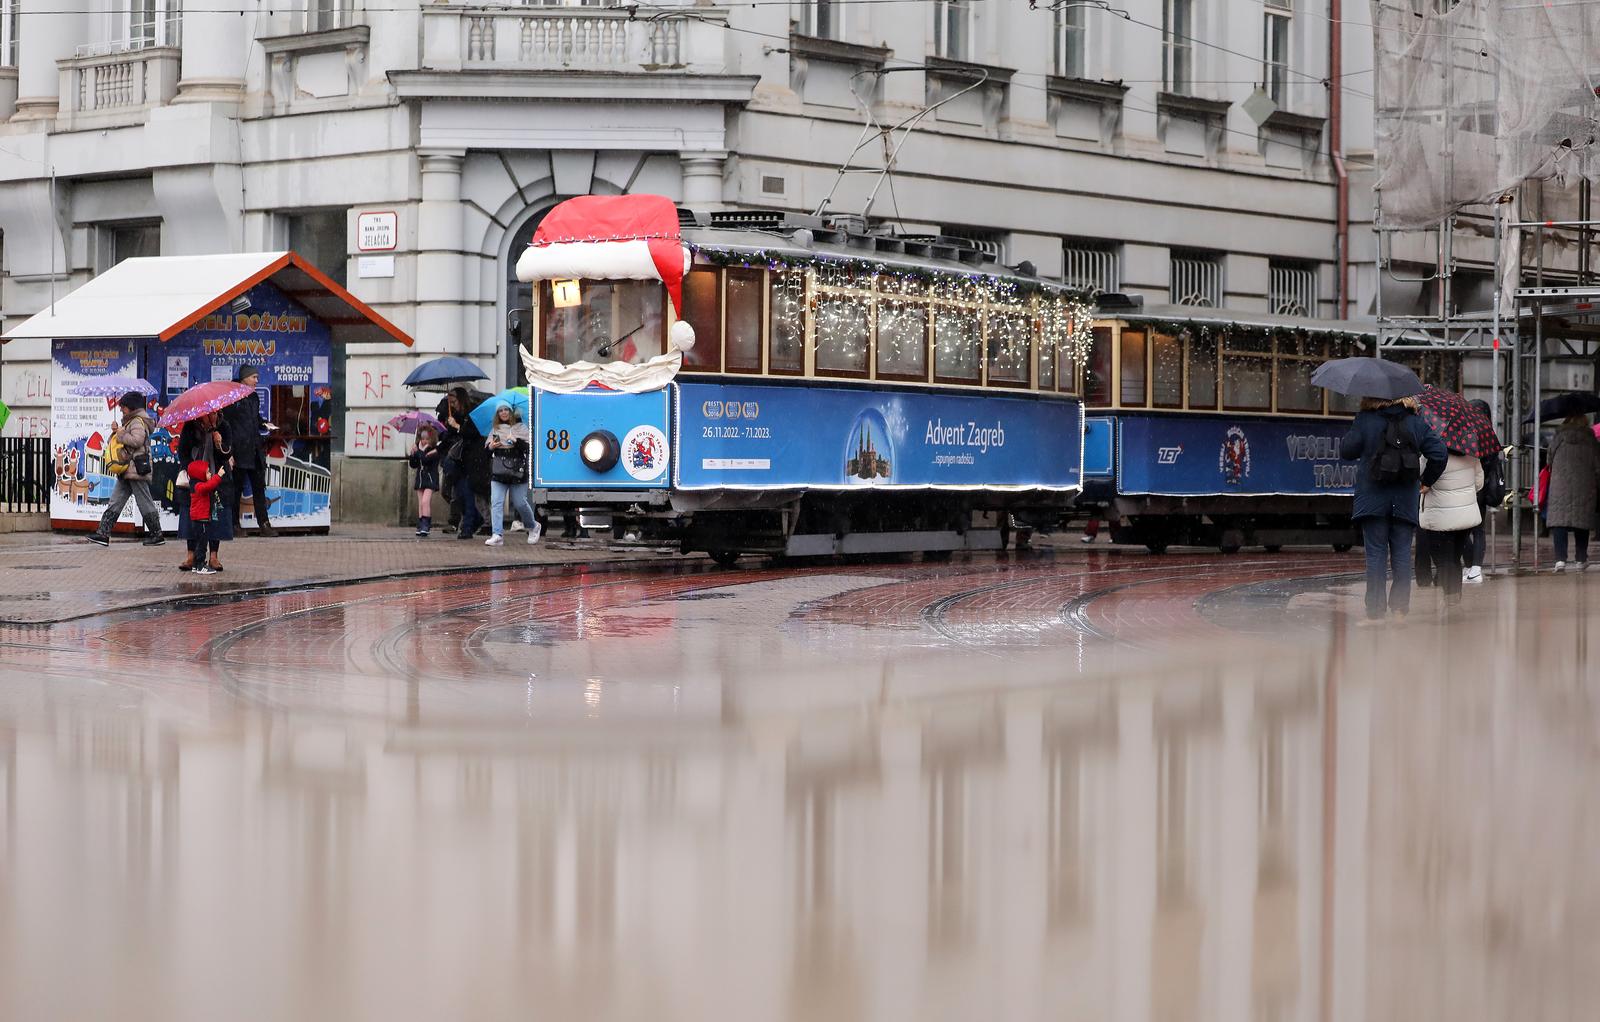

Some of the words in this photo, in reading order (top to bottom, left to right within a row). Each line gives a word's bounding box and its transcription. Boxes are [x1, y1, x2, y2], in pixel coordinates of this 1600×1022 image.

[364, 233, 390, 247] JELAČIĆA
[236, 311, 307, 333] BOŽIĆNI
[202, 337, 276, 357] TRAMVAJ
[273, 364, 313, 375] PRODAJA
[277, 373, 309, 382] KARATA
[354, 420, 391, 451] EMF
[545, 429, 571, 452] 88
[702, 426, 740, 438] 26.11.2022.
[925, 418, 965, 446] Advent
[967, 420, 1005, 454] Zagreb
[1157, 446, 1183, 464] ZET
[1286, 434, 1341, 461] VESELI
